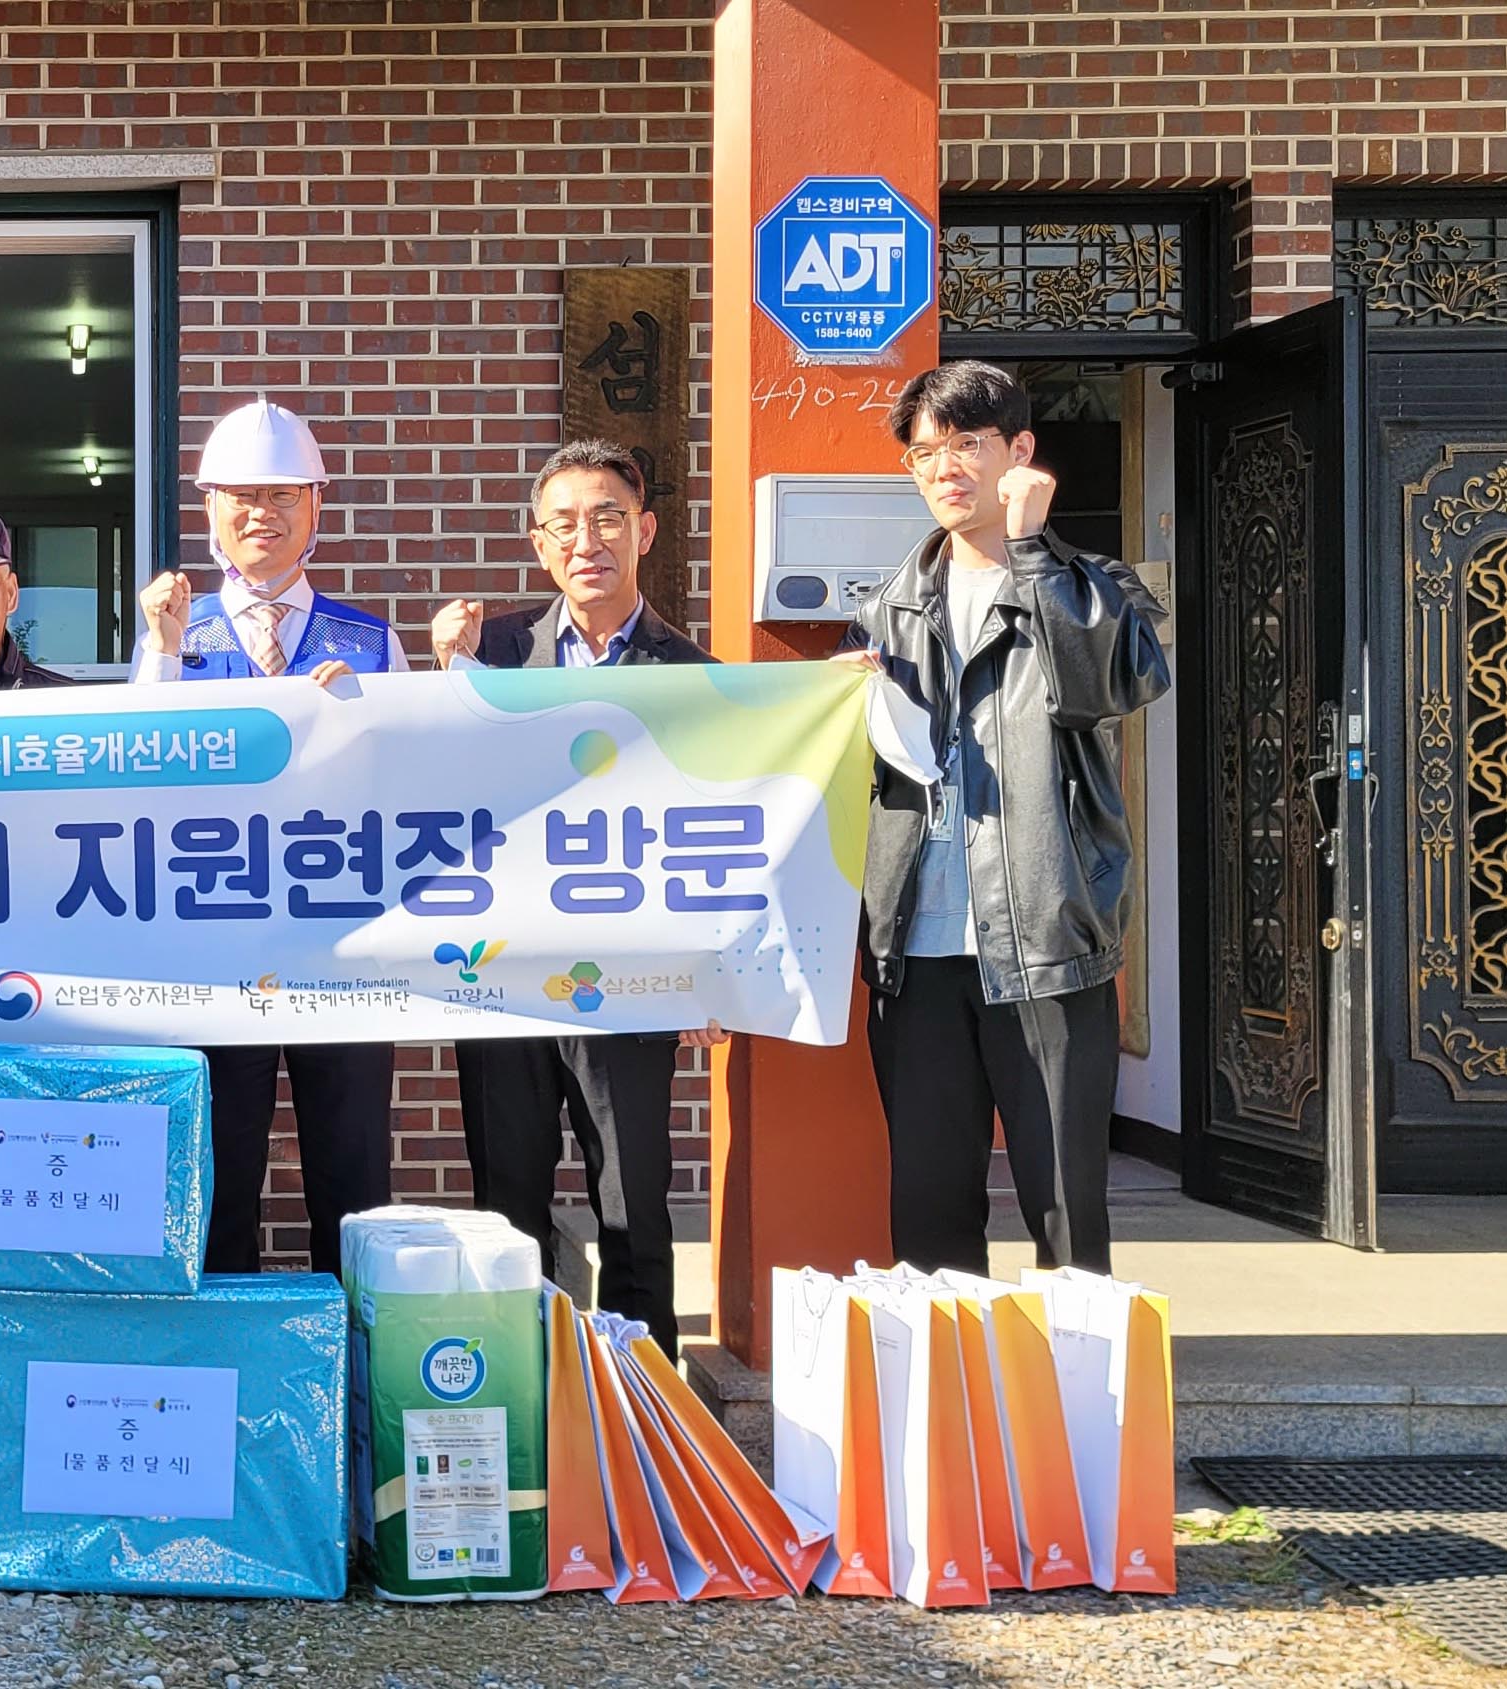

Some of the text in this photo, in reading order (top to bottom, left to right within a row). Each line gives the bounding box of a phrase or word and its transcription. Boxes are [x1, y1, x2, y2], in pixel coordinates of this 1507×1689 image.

[796, 197, 893, 213] 캡스경비구역
[814, 327, 873, 339] 1588-6400
[53, 808, 508, 922] 지원현장
[544, 804, 771, 914] 방문
[286, 977, 410, 992] Korea Energy Foundation
[443, 986, 505, 1003] 고양시
[604, 974, 694, 995] 삼성건설
[54, 983, 214, 1008] 산업통상자원부
[289, 991, 410, 1014] 한국에너지재단
[45, 1154, 69, 1177] 증
[440, 1372, 468, 1386] 나라
[116, 1418, 140, 1441] 증
